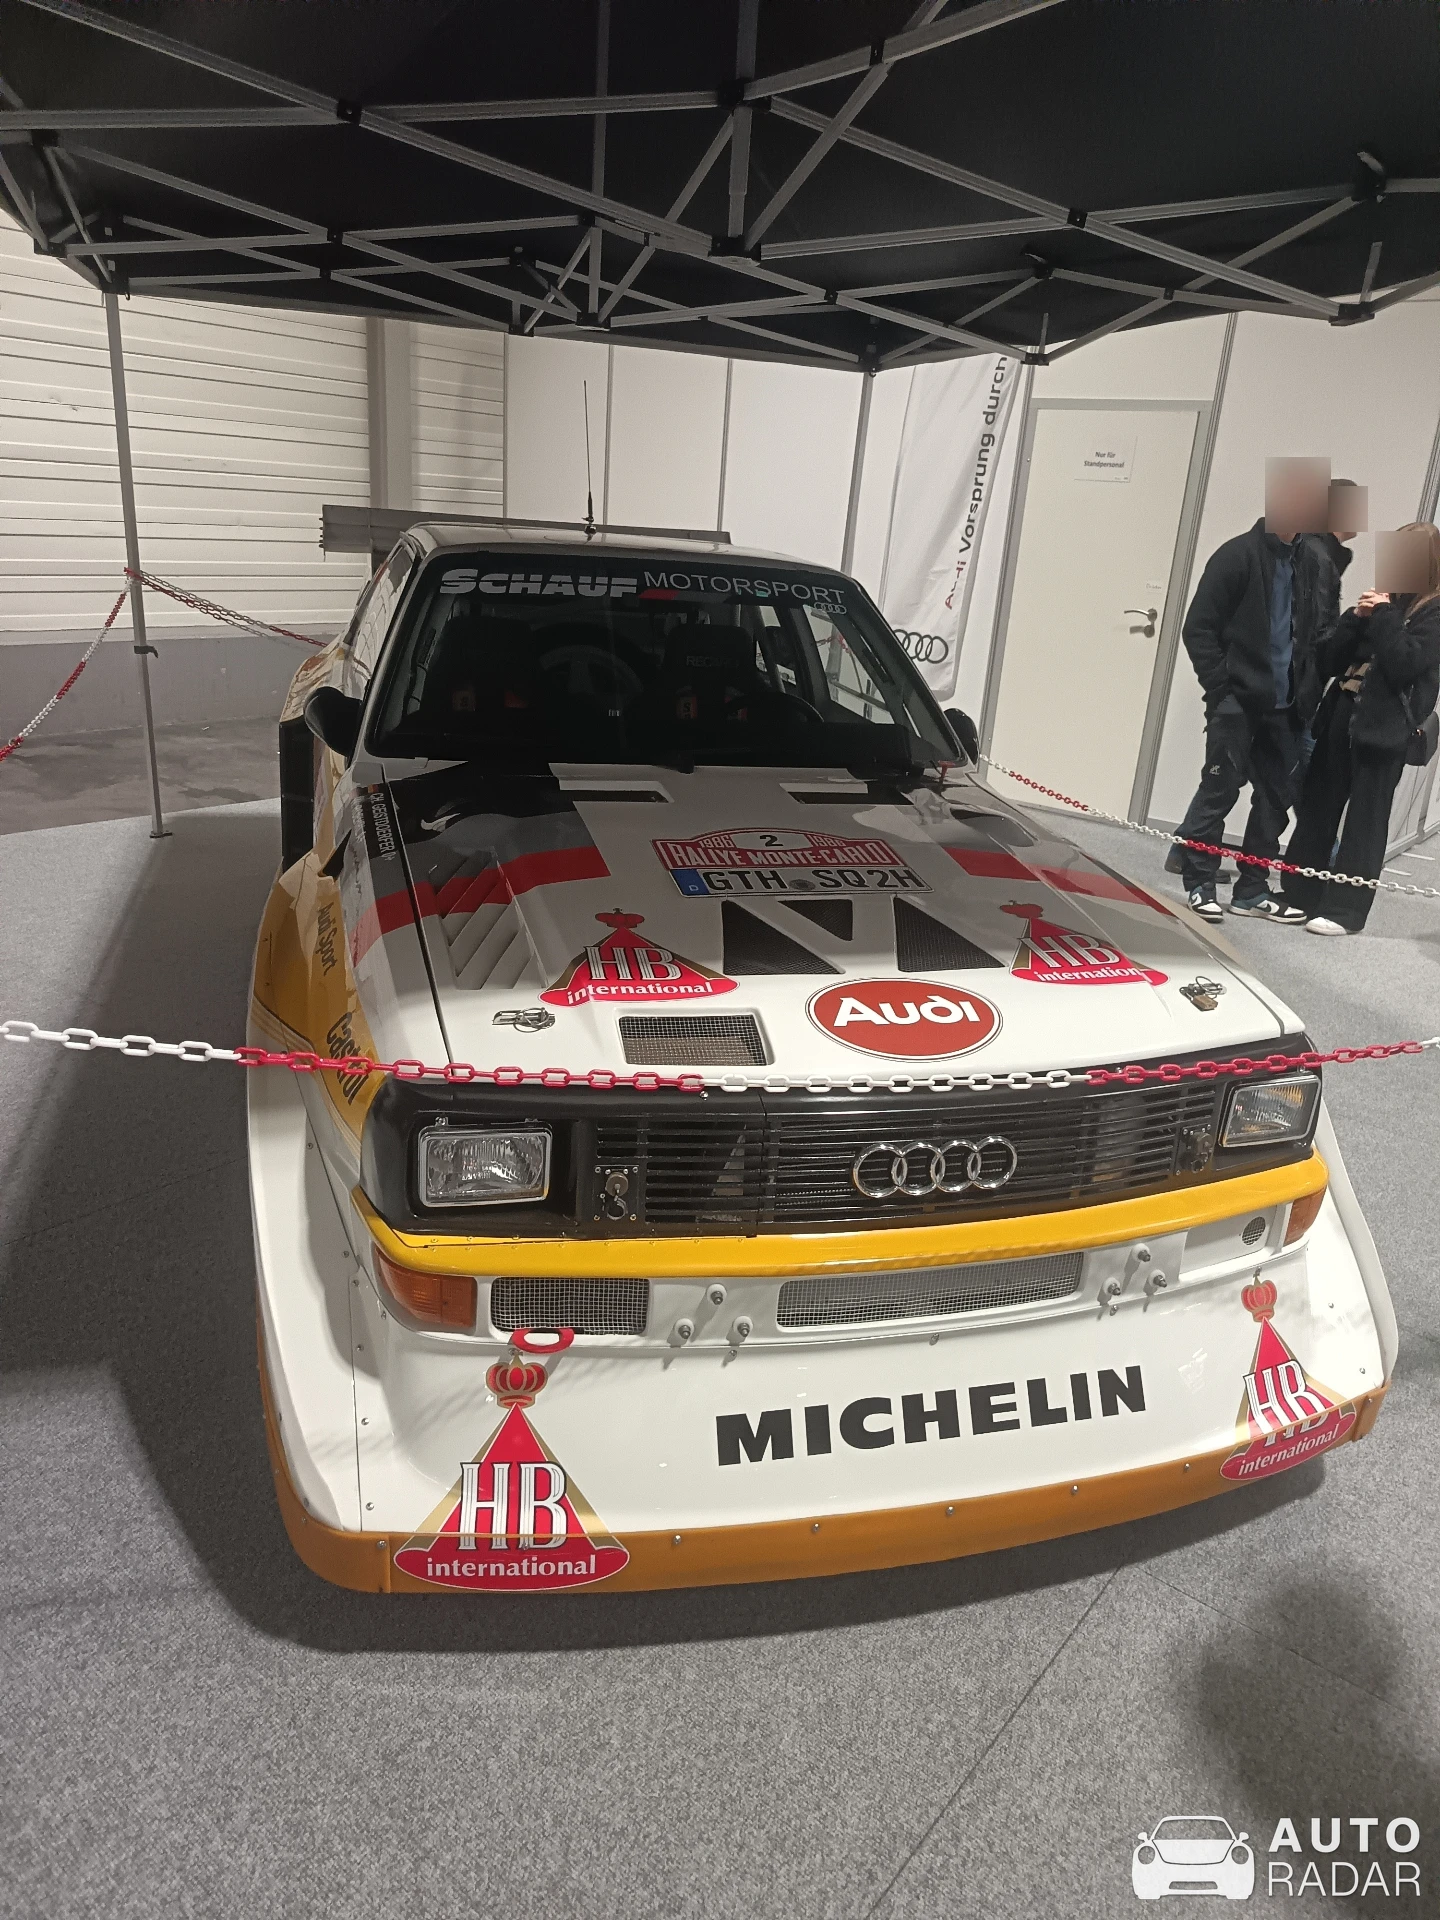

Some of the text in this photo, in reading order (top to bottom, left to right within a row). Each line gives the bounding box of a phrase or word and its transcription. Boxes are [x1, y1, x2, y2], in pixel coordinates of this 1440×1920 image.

[1083, 460, 1125, 468] Standpersonal
[945, 357, 1008, 610] Ai Vorsprung durch
[439, 568, 845, 603] SCHAUF MOTORSPORT
[668, 843, 894, 867] RALLYE MONTE-CARLO
[700, 834, 846, 849] 1986 2 1986
[688, 869, 925, 892] D GTH SQ2H
[315, 927, 338, 977] Sport
[583, 945, 682, 981] HB
[1019, 933, 1122, 968] HB
[1033, 966, 1154, 983] internationl
[566, 982, 713, 1005] international
[833, 994, 981, 1028] Audi
[715, 1365, 1146, 1466] MICHELIN
[1242, 1358, 1331, 1447] HB
[1238, 1423, 1340, 1476] international
[457, 1461, 568, 1551] HB
[427, 1554, 596, 1578] international
